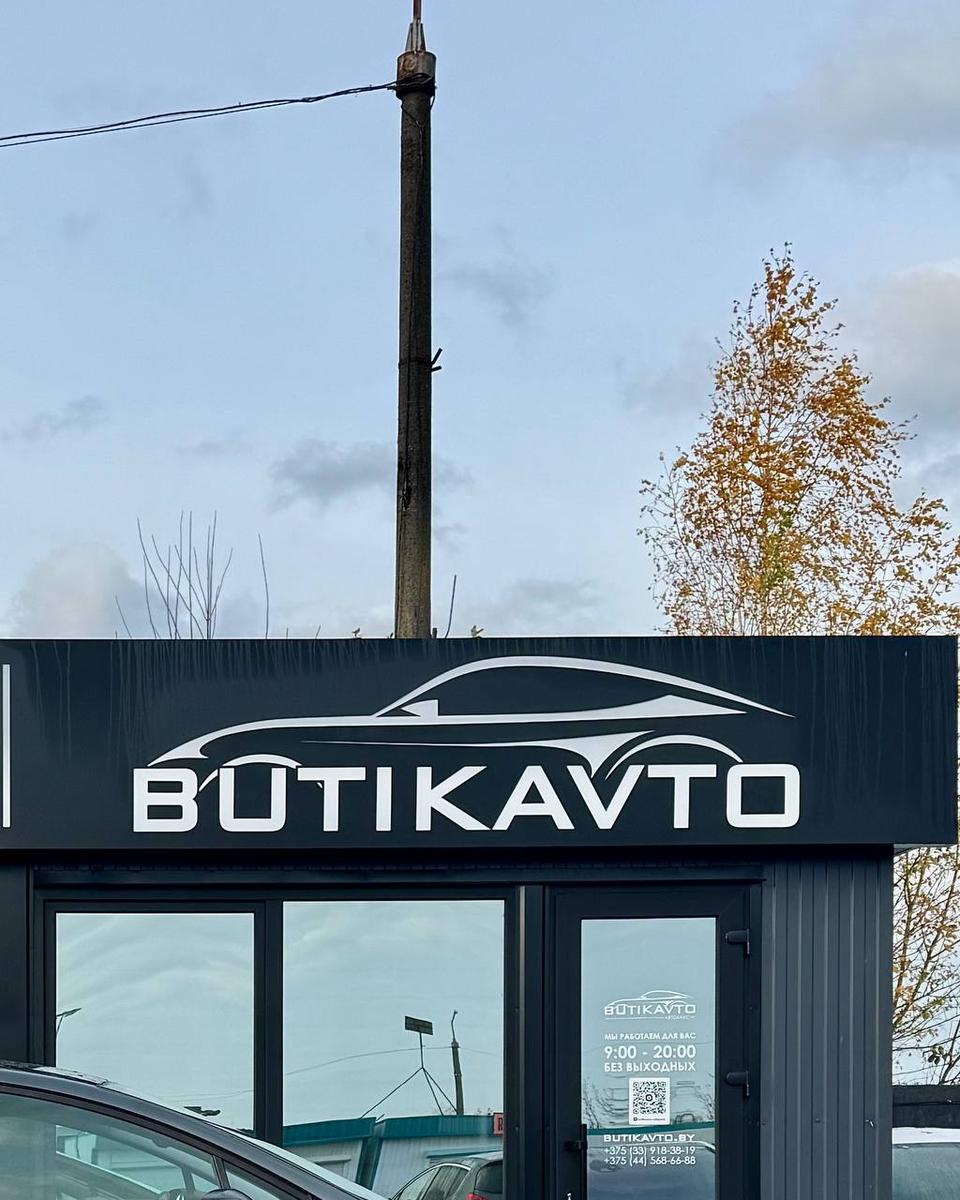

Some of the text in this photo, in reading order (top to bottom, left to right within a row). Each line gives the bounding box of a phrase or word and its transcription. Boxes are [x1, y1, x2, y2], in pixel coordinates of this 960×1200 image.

[133, 762, 801, 833] BUTIKAVTO
[604, 1004, 696, 1015] BUTIKAVTO
[604, 1033, 618, 1041] МЫ
[620, 1033, 661, 1041] РАБОТАЕМ
[680, 1032, 696, 1040] ВАС
[604, 1045, 637, 1059] 9:00
[653, 1045, 696, 1058] 20:00
[604, 1061, 696, 1072] БЕЗ ВЫХОДНЫХ
[603, 1134, 695, 1142] BUTIKAVTO.BY
[604, 1146, 696, 1156] +375 (33) 918-38-19
[604, 1156, 696, 1167] +375 (44) 568-66-88
